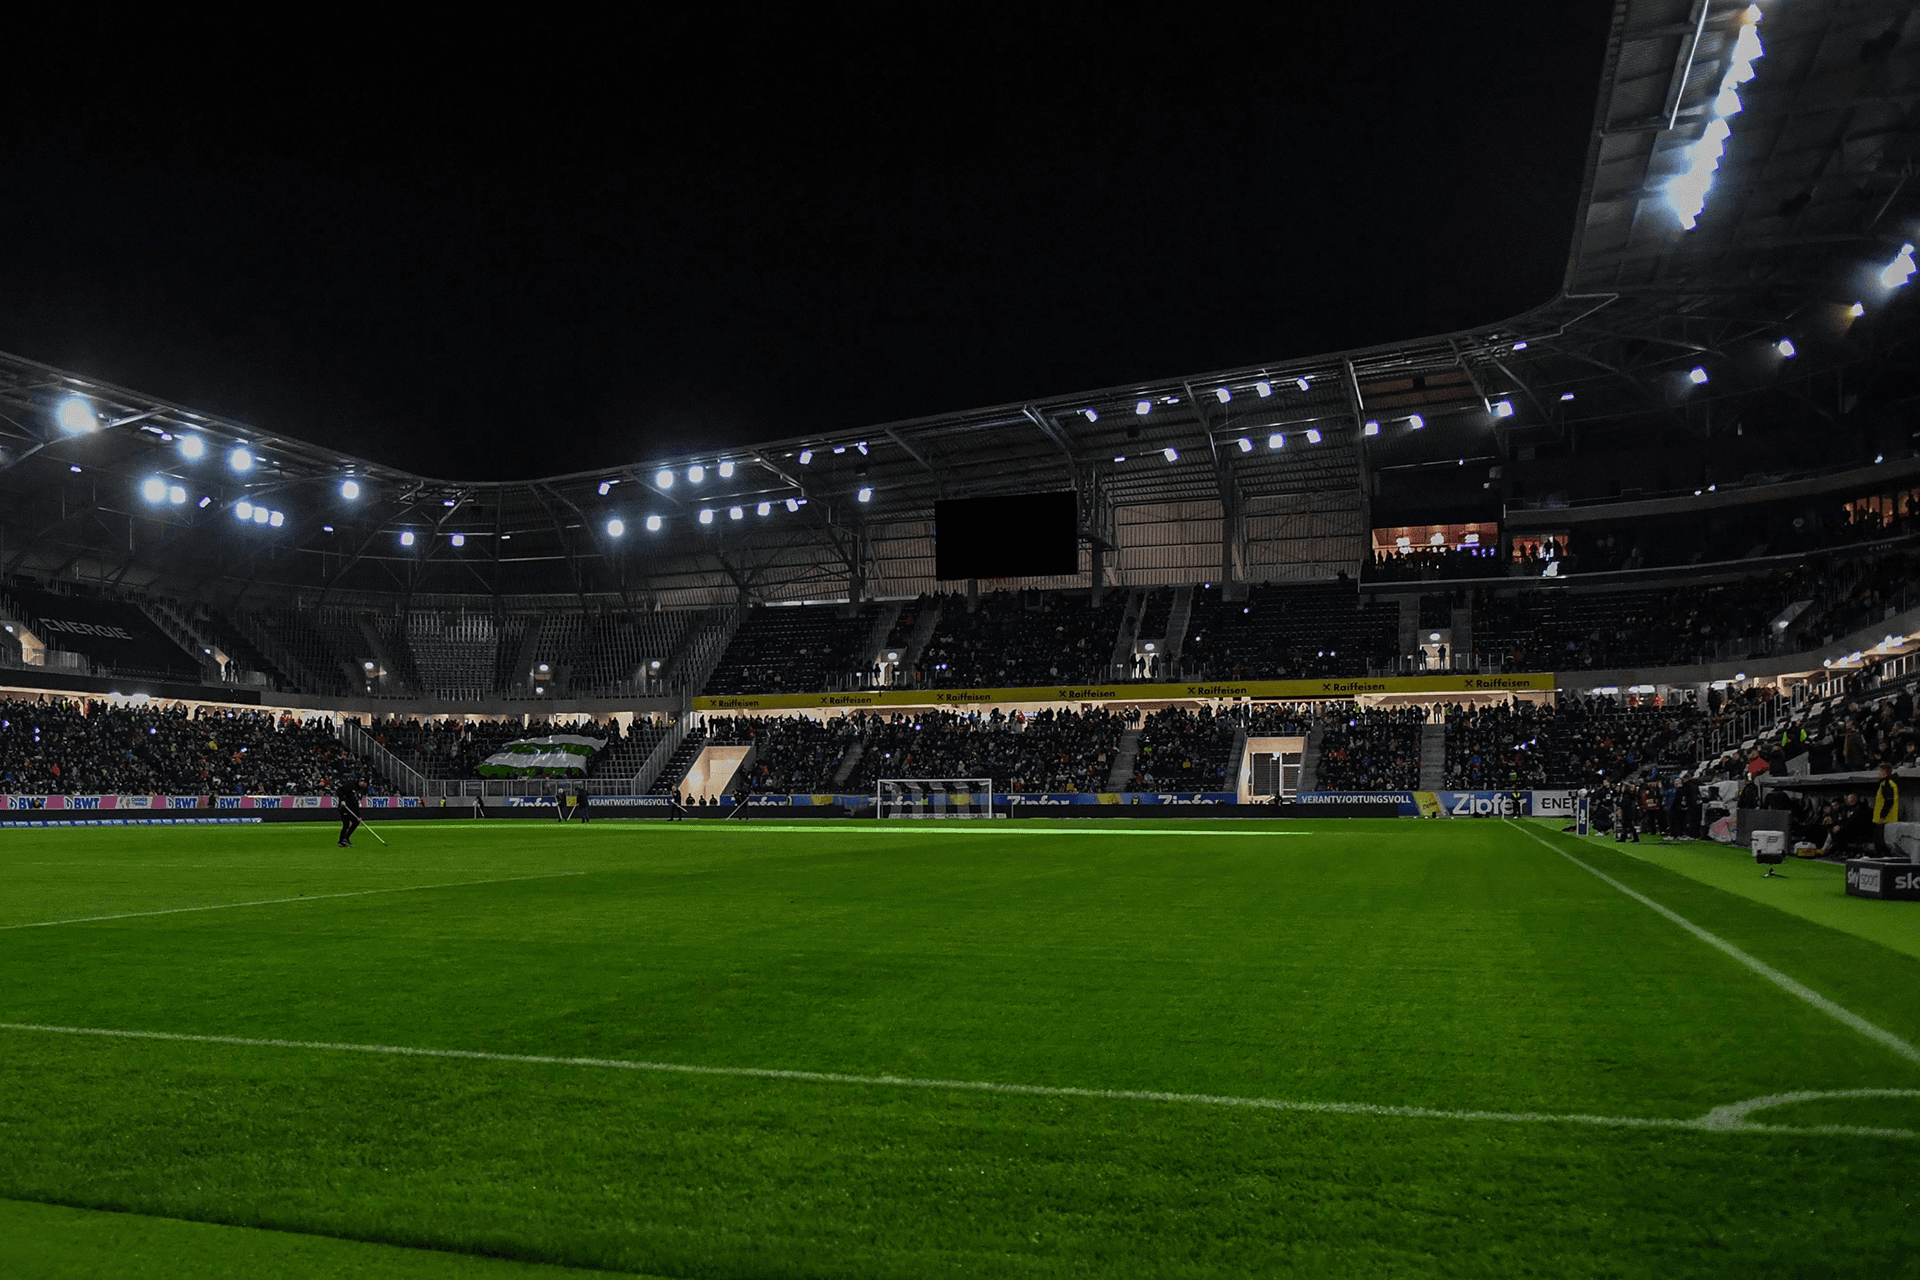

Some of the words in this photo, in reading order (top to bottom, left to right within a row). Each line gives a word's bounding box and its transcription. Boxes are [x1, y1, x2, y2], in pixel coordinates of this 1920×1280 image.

[38, 617, 133, 641] ENERGIE
[1333, 682, 1385, 692] Raiffeisen
[1476, 678, 1530, 688] Raiffeisen
[1069, 690, 1115, 699] Raiffeisen
[1198, 686, 1246, 695] Raiffeisen
[829, 696, 871, 705] Raiffeisen
[945, 692, 990, 701] Raiffeisen
[718, 699, 759, 708] Raiffeisen
[74, 797, 100, 809] BWT
[175, 797, 198, 809] BWT
[219, 798, 240, 809] BWT
[261, 798, 280, 809] BWT
[372, 797, 389, 808] BWT
[403, 798, 419, 807] BWT
[587, 798, 669, 807] VERANTWORTUNGSVOLL
[1158, 795, 1225, 805] Zif
[1302, 795, 1411, 805] VERANTWORTUNGSVOLL
[1452, 793, 1527, 815] Zipfer
[1541, 797, 1573, 809] ENE
